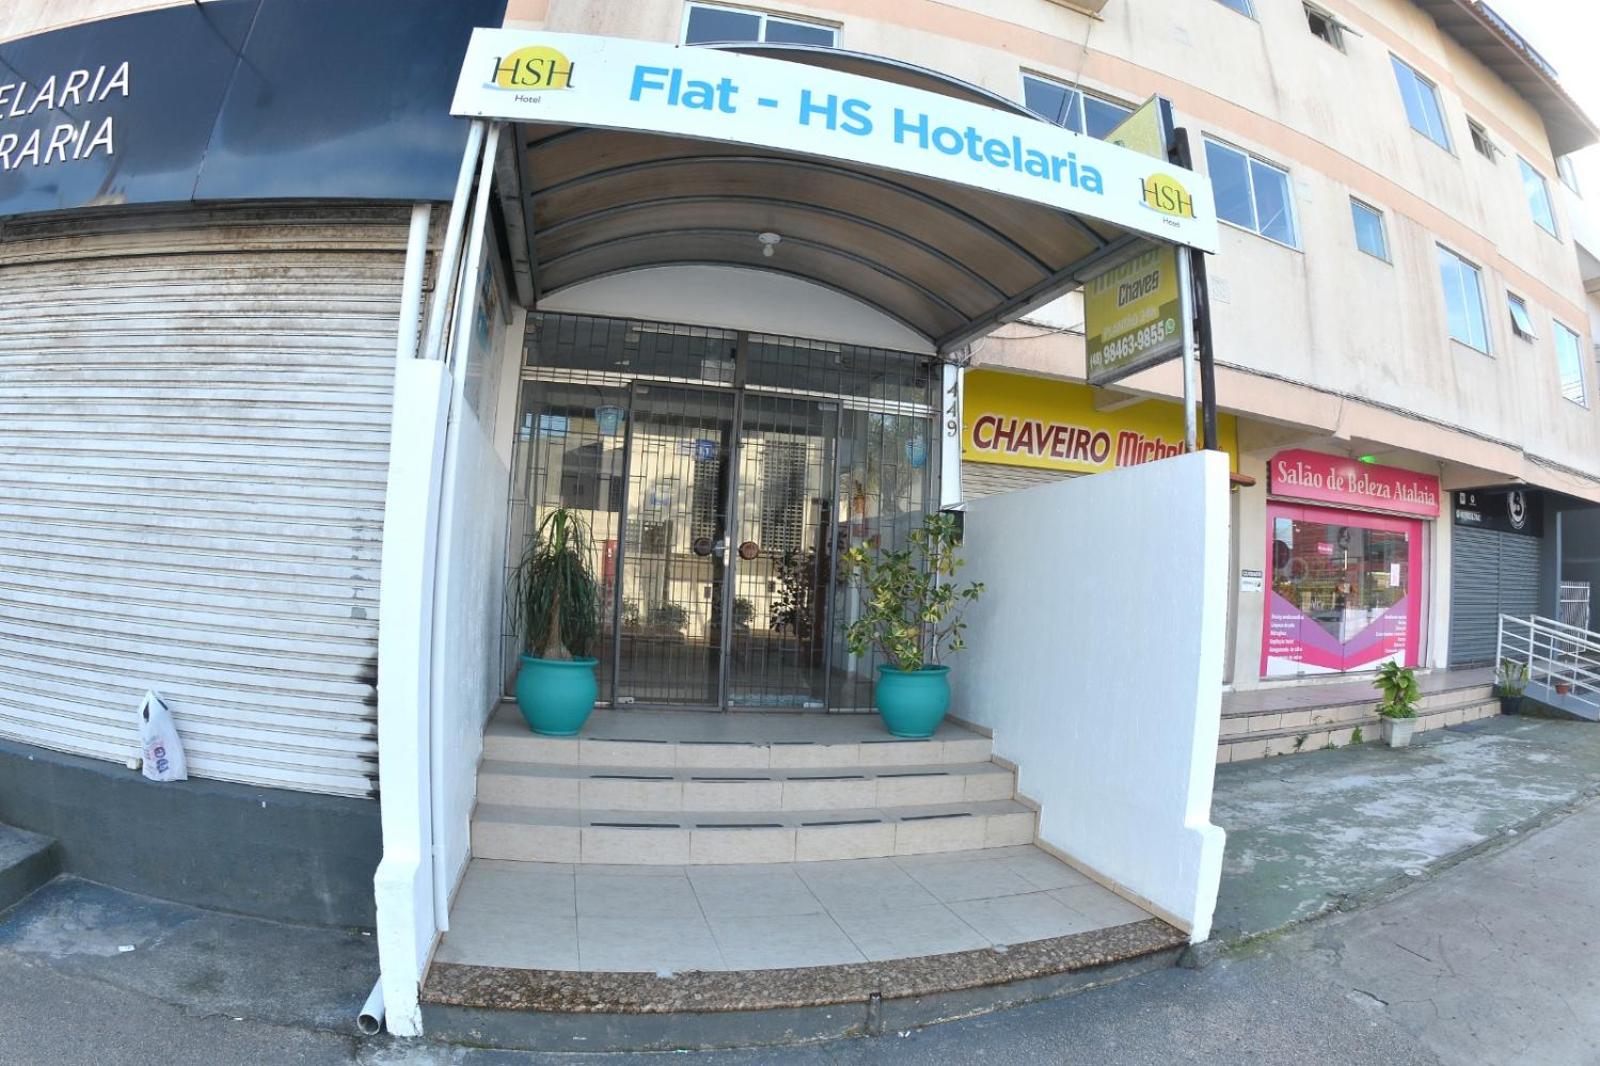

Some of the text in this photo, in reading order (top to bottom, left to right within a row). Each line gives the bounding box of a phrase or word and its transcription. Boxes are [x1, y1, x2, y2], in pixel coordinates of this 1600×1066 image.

[490, 56, 575, 89] HSH
[514, 94, 541, 104] Hotel
[0, 116, 114, 170] RARIA
[628, 64, 1105, 196] Flat - HS Hotelaria
[1138, 177, 1197, 219] HSH
[1117, 269, 1160, 308] Chaves
[973, 415, 1111, 463] CHAVEIRO
[1278, 460, 1436, 506] Salão de Beleza Atalaia
